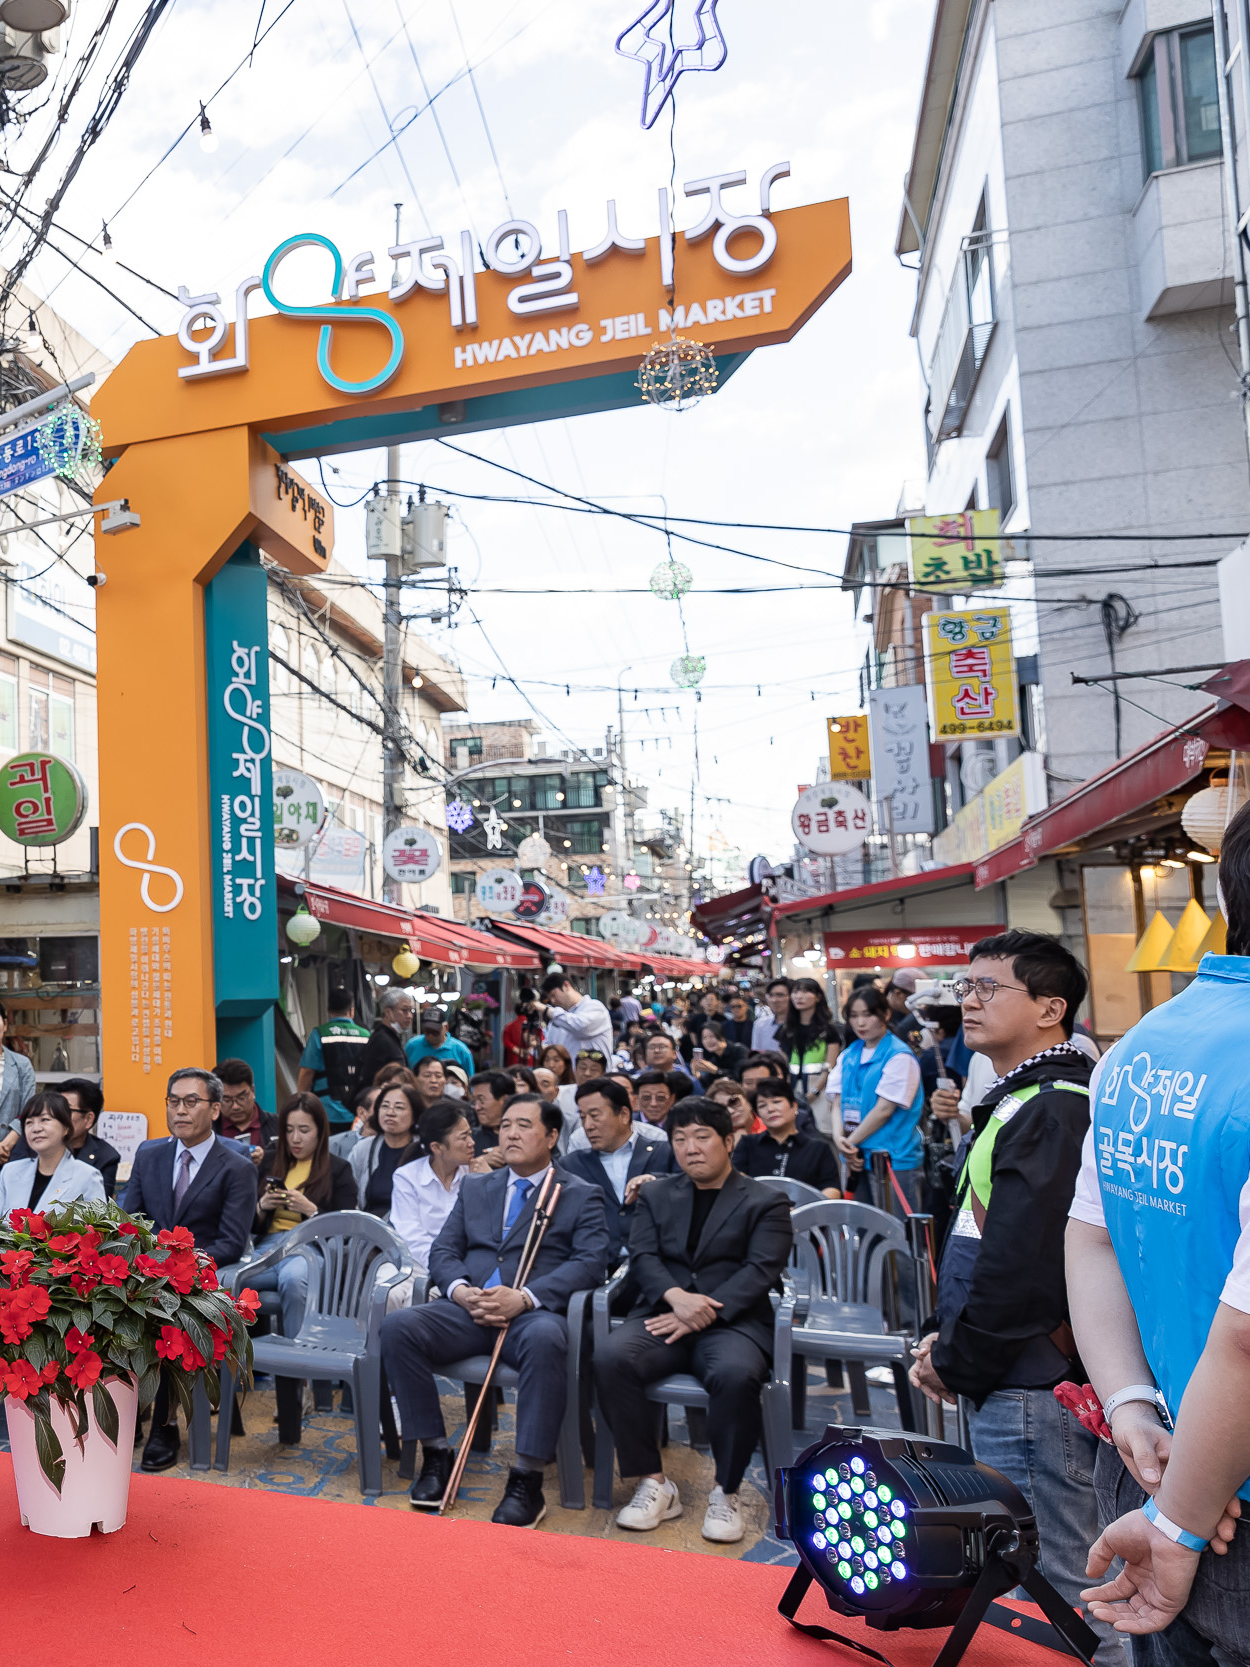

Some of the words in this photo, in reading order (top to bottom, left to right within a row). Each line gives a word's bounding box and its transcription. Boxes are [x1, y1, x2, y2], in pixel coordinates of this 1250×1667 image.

[178, 161, 791, 396] 화양제일시장
[454, 324, 593, 369] HWAYANG
[600, 312, 652, 343] JEIL
[658, 288, 776, 332] MARKET
[938, 614, 1002, 644] 황금
[950, 648, 998, 720] 축산
[939, 720, 1014, 735] 499-6494
[8, 757, 57, 838] 과일
[224, 640, 270, 921] 화양제일시장
[221, 795, 231, 850] HWAYANG
[798, 808, 867, 836] 황금축산
[222, 852, 232, 873] JEIL
[223, 877, 234, 919] MARKET
[1099, 1126, 1188, 1194] 골목시장
[1103, 1181, 1134, 1200] HWAYANG
[1134, 1191, 1148, 1206] JEIL
[1149, 1196, 1187, 1216] MARKET
